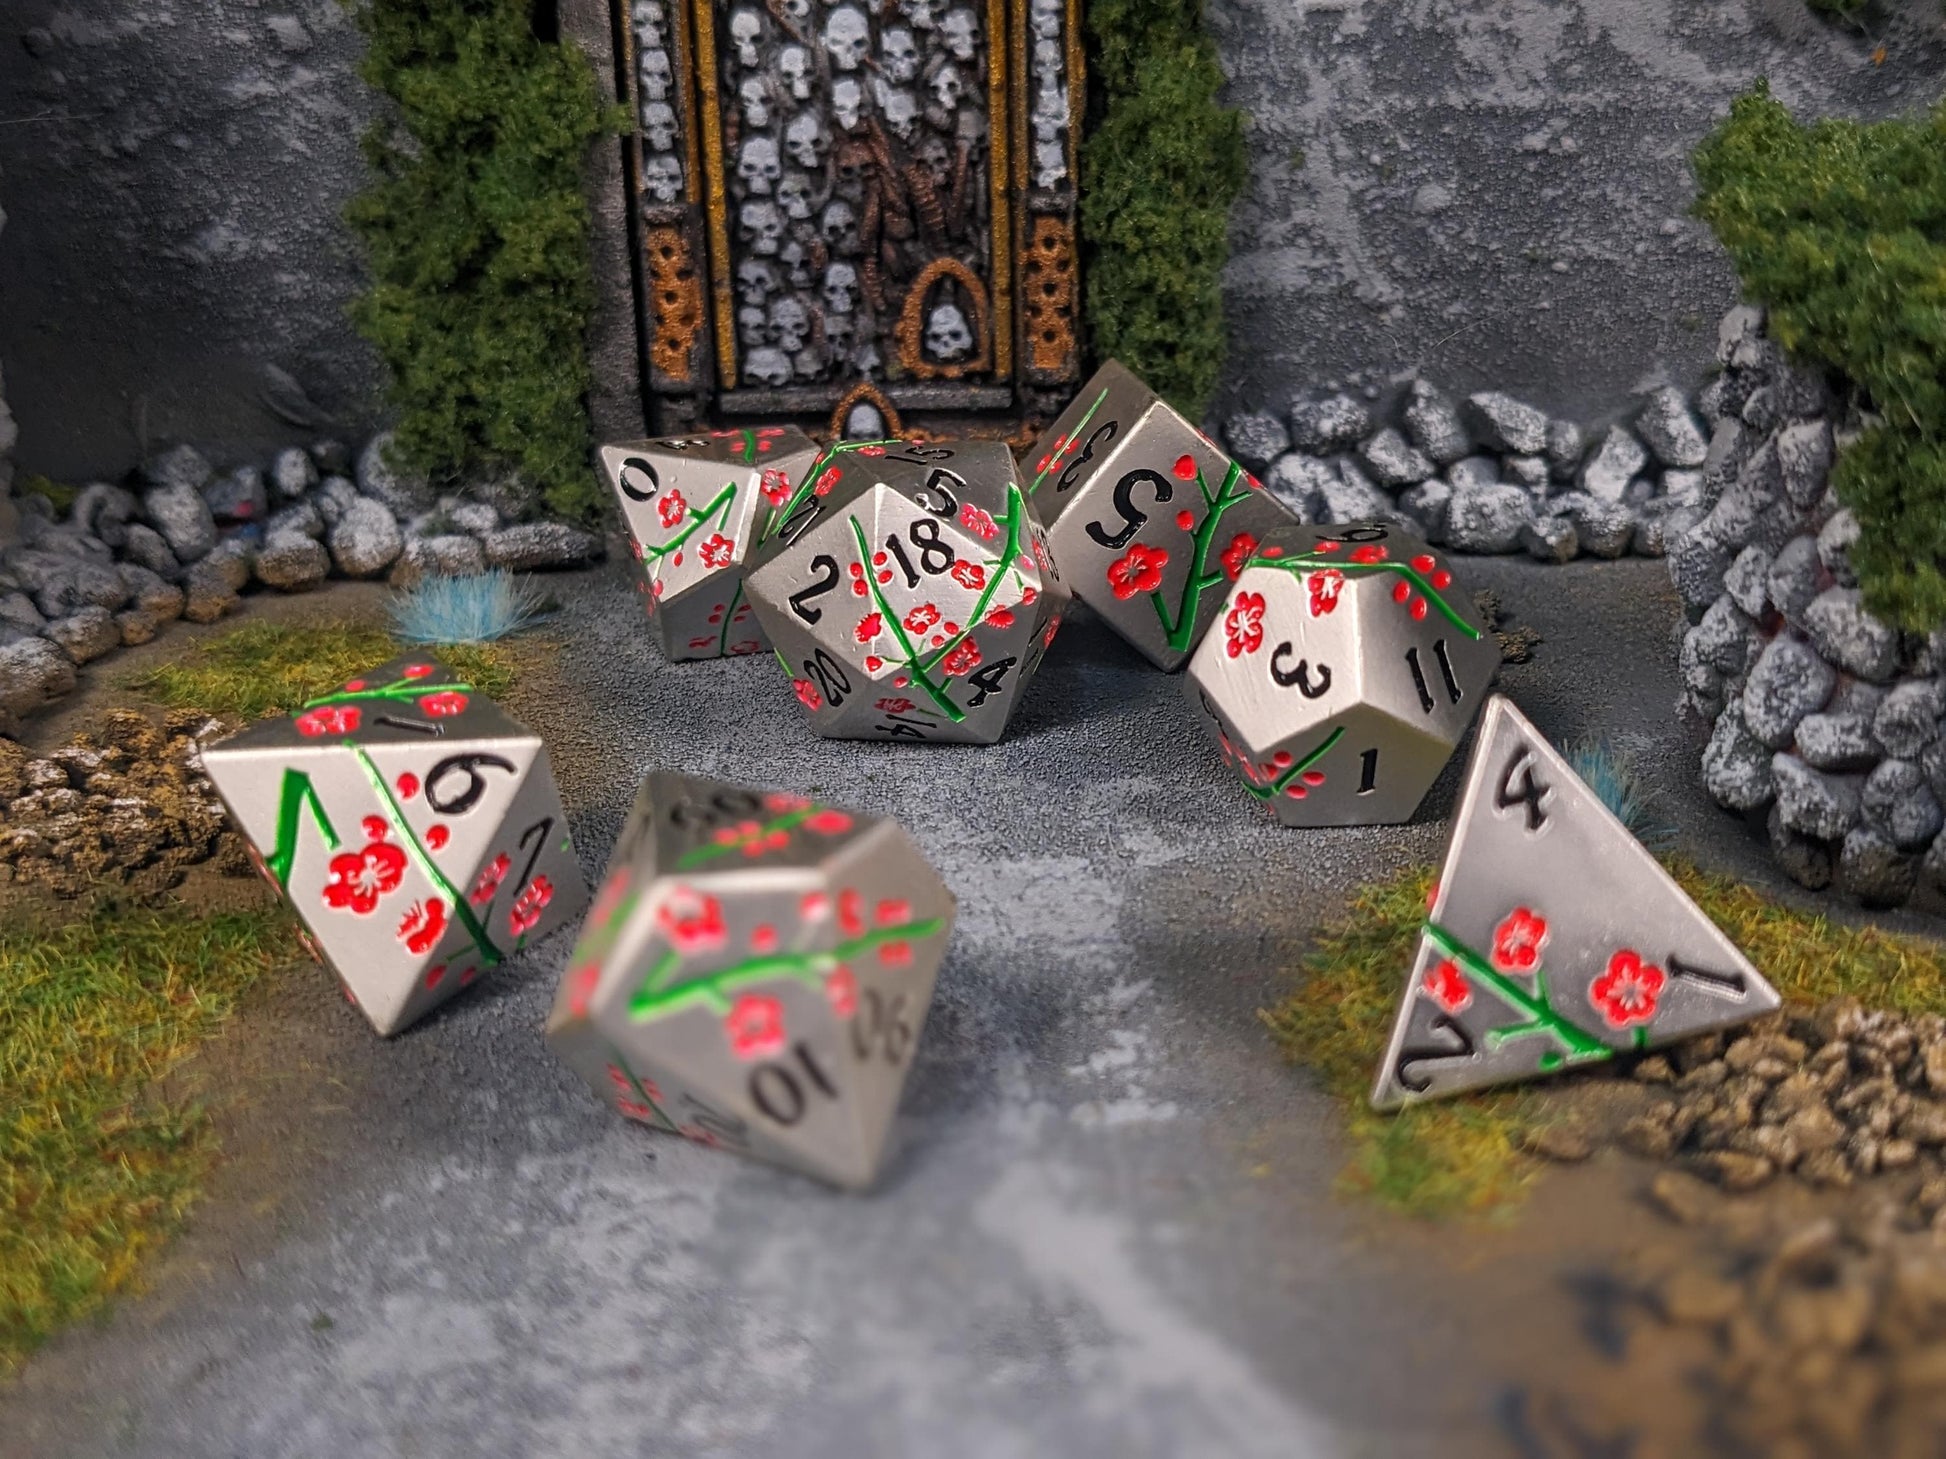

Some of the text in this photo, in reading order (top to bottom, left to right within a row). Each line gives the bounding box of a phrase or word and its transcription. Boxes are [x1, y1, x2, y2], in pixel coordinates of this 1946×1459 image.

[620, 457, 660, 502] 0
[1057, 421, 1118, 492] 3
[915, 468, 967, 519] 5
[1085, 469, 1173, 549] 5
[886, 518, 956, 588] 18
[789, 554, 839, 625] 2
[803, 648, 852, 707] 20
[967, 656, 1017, 708] 4
[1270, 642, 1331, 699] 3
[1405, 639, 1463, 714] 11
[875, 714, 937, 739] 14
[424, 753, 519, 814] 6
[1357, 748, 1379, 796] 1
[1493, 745, 1556, 838] 4
[1666, 953, 1748, 998] 1
[1399, 1014, 1477, 1092] 2
[748, 1041, 840, 1127] 10
